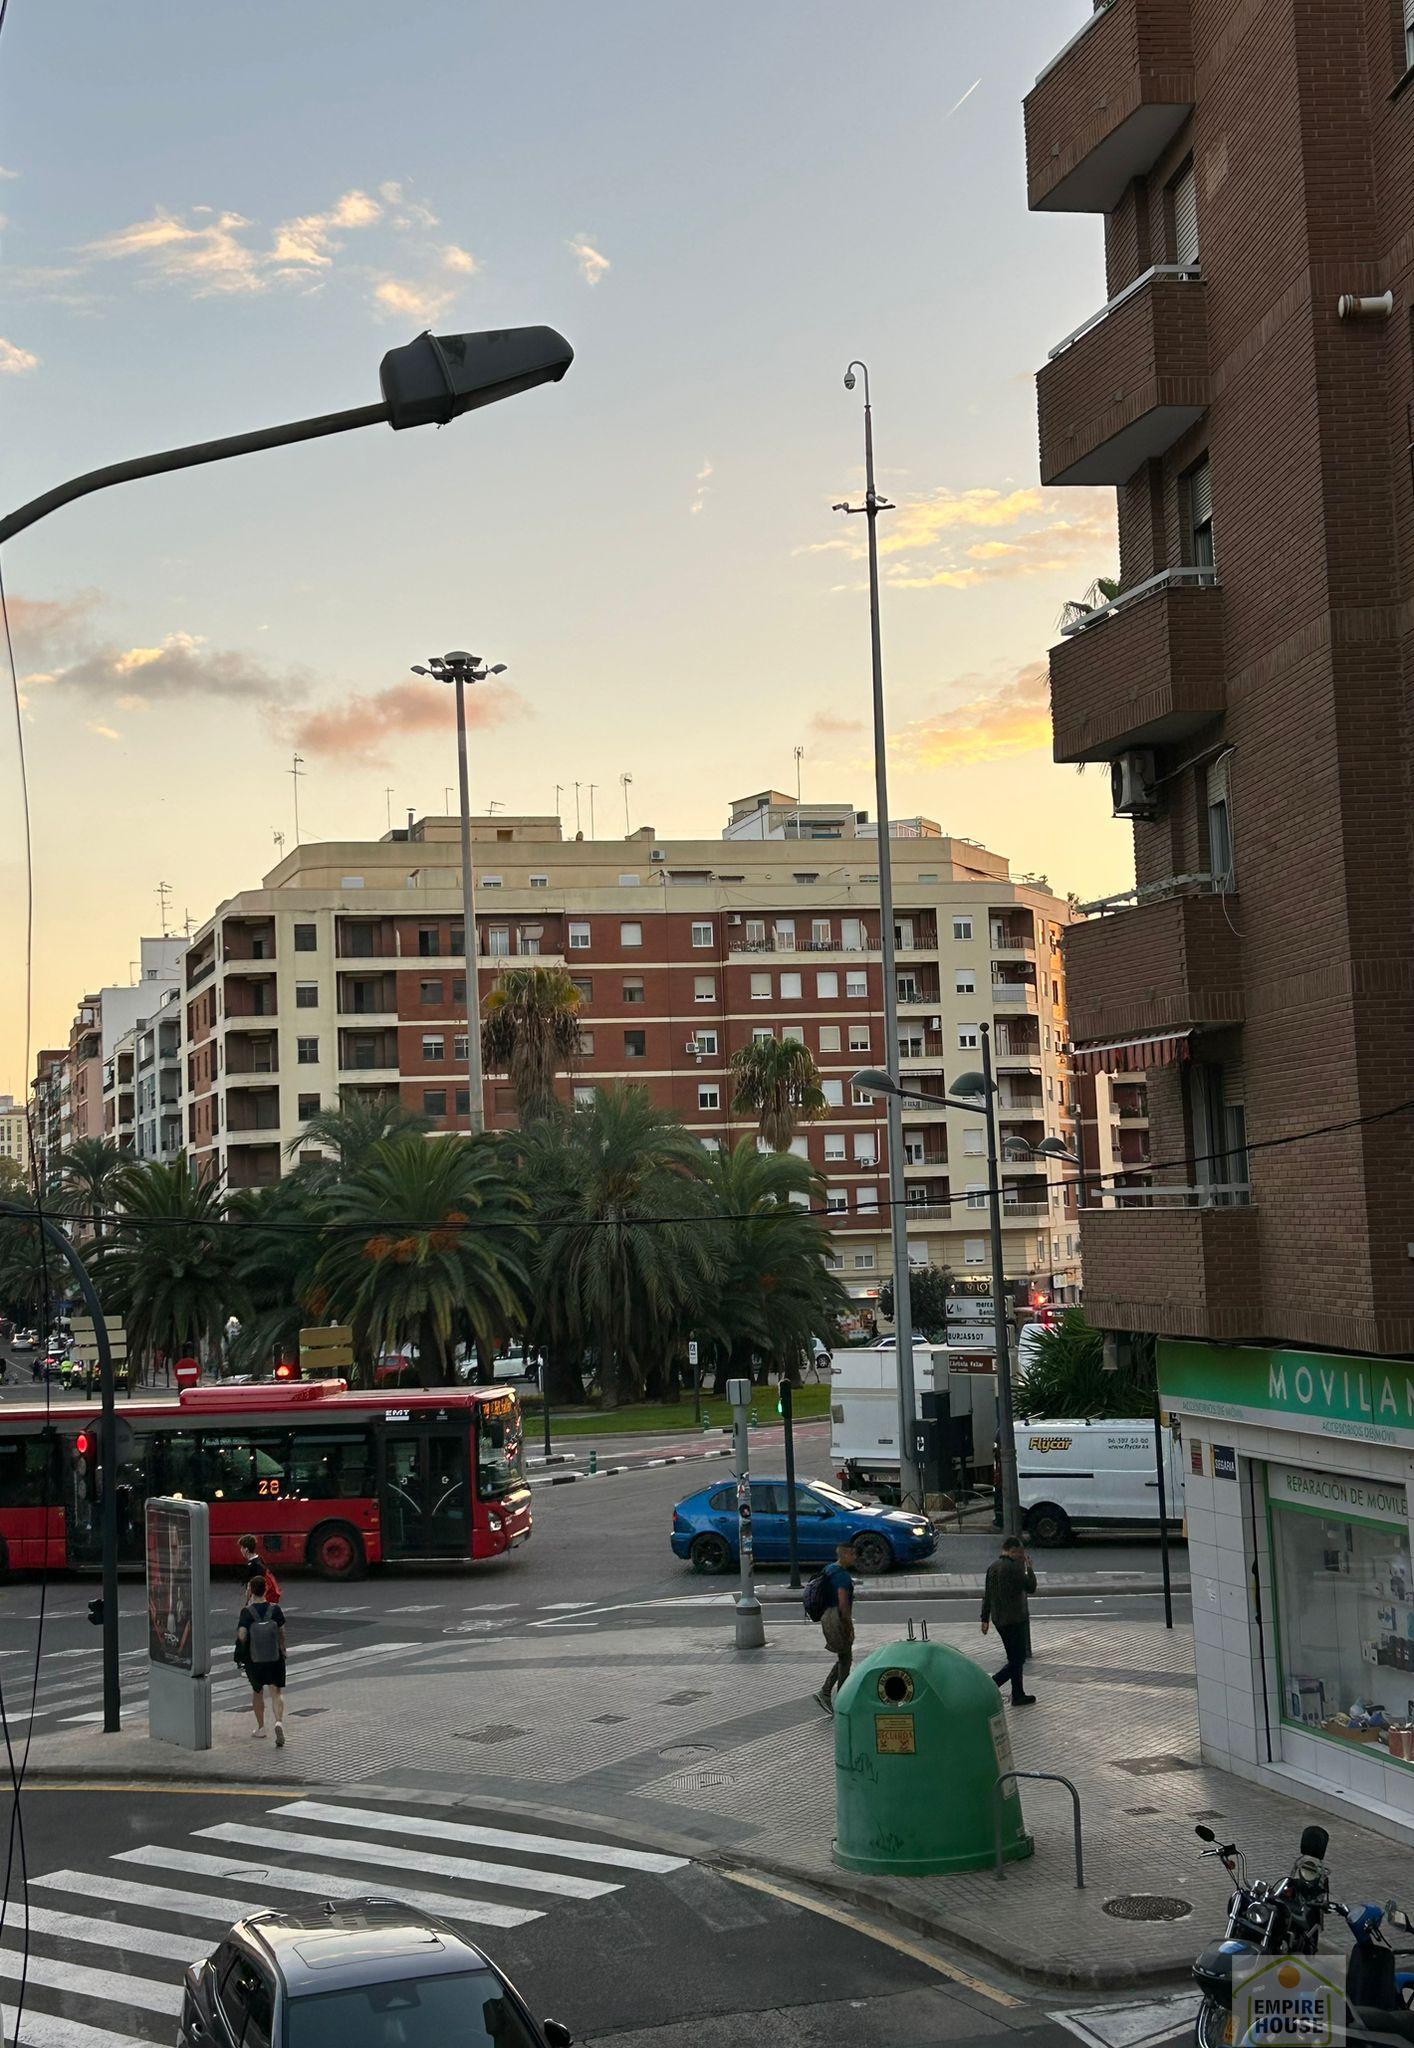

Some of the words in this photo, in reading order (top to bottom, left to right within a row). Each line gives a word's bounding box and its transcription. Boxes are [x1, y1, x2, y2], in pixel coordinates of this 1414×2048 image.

[1322, 1421, 1363, 1436] ACCESORIOS
[1029, 1437, 1073, 1453] Flycar
[259, 1480, 280, 1495] 28
[1286, 1474, 1347, 1502] REPARACIÓN
[1350, 1488, 1364, 1506] DE
[1367, 1489, 1408, 1516] MÓVILE
